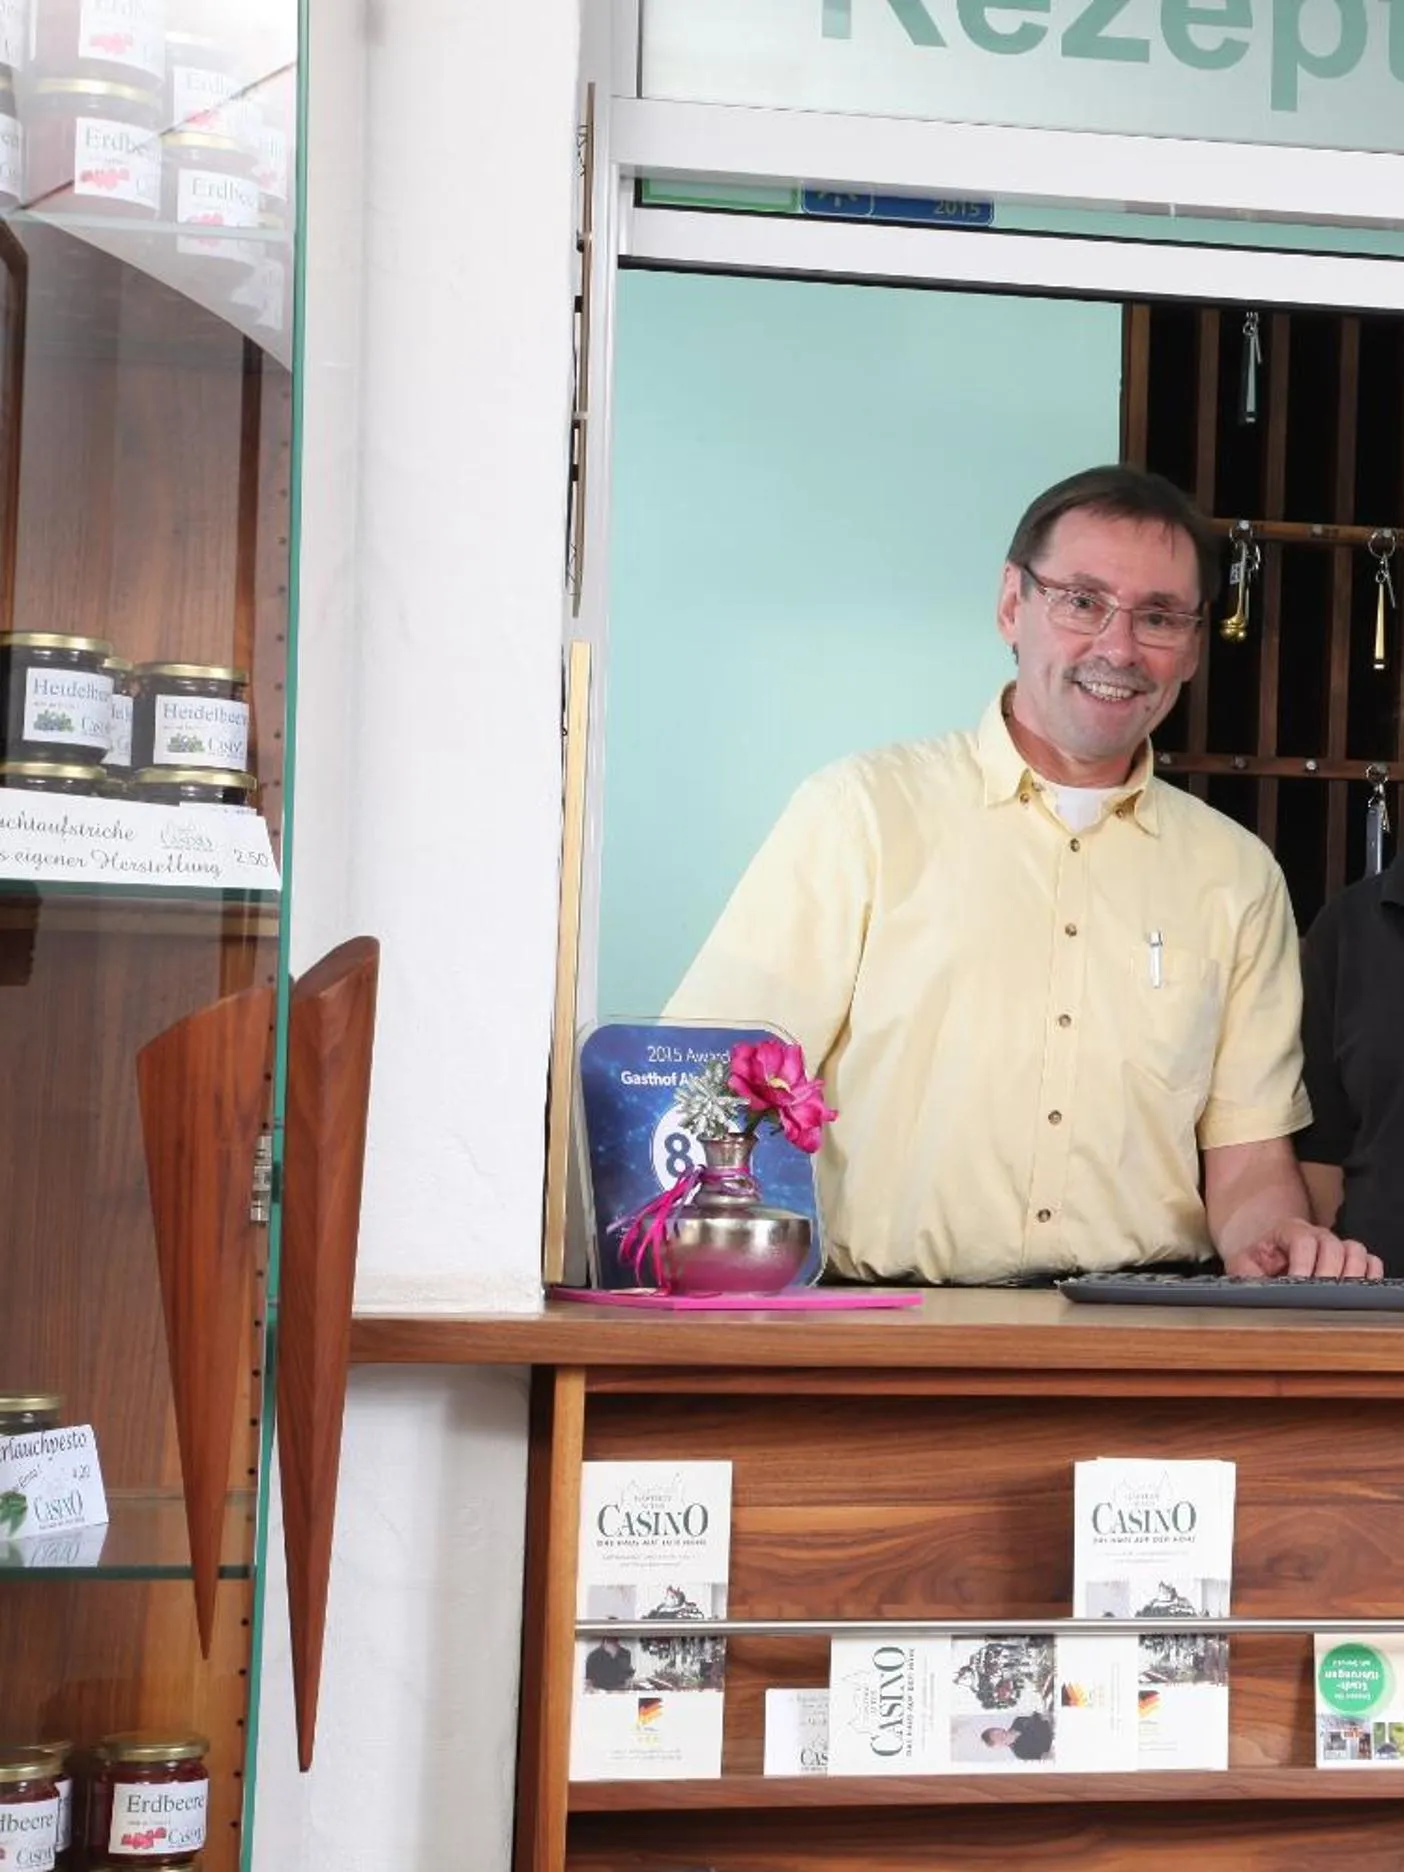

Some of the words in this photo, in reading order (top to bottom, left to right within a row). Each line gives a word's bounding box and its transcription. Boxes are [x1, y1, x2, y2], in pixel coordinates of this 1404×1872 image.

[933, 199, 982, 217] 2015
[647, 1045, 682, 1063] 2015
[620, 1070, 677, 1087] Gasthof
[597, 1502, 709, 1537] CASINO
[1092, 1500, 1197, 1535] CASINO
[870, 1646, 905, 1757] CASINO
